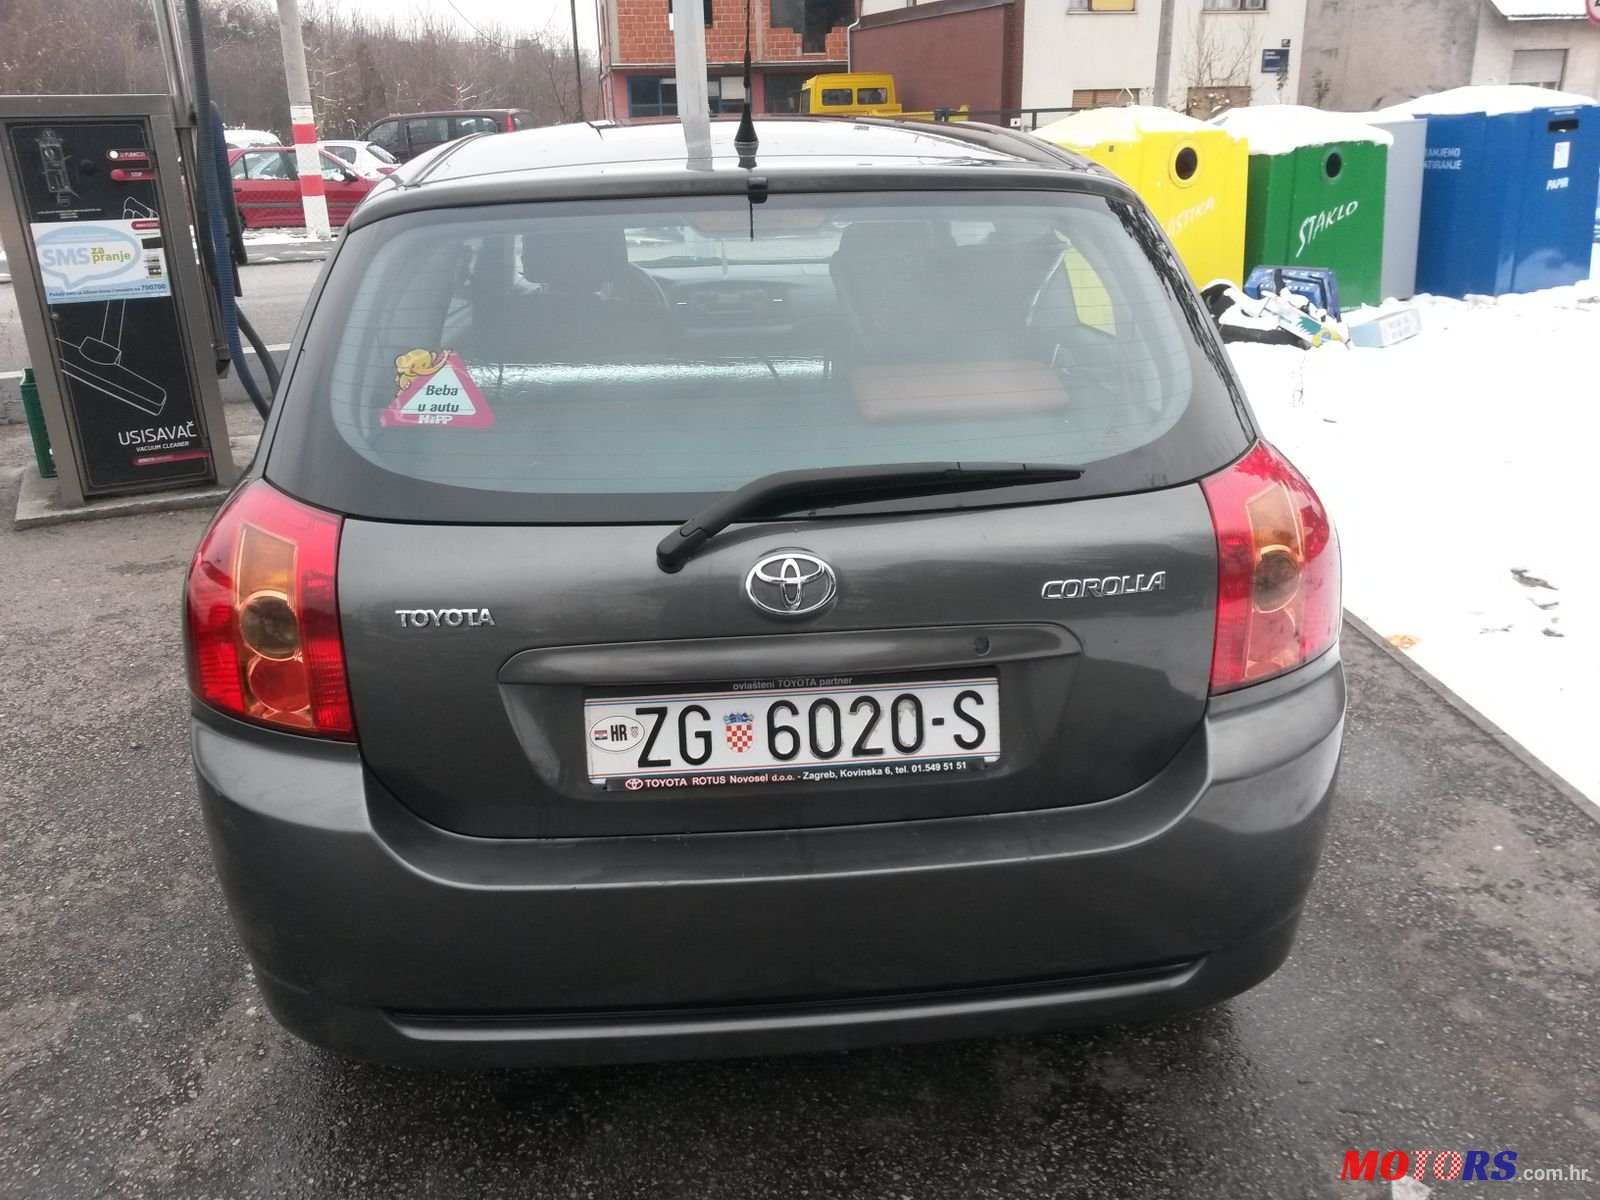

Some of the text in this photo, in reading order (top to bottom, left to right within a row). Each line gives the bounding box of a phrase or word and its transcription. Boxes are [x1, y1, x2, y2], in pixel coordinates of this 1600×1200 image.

[1163, 195, 1215, 239] ASTIKA
[1296, 201, 1358, 258] STAKLO
[41, 247, 91, 267] SMS
[91, 247, 104, 255] za
[92, 250, 132, 264] pranje
[425, 384, 458, 396] Beba
[417, 402, 460, 413] u autu
[418, 414, 453, 424] HiPP
[118, 420, 197, 445] USISAVAČ
[136, 440, 190, 452] VACUUM CLEANER
[1041, 570, 1166, 600] COROLLA
[395, 608, 495, 627] TOYOTA
[732, 677, 853, 690] ovlašteni TOYOTA partner
[610, 724, 628, 742] HR
[635, 690, 986, 768] ZG 6020-S
[645, 777, 688, 788] TOYOTA
[692, 775, 726, 785] ROTUS
[730, 773, 768, 784] Novosel
[771, 772, 795, 782] d.o.o.
[803, 770, 838, 781] Zagreb,
[840, 767, 883, 778] Kovinska
[885, 766, 893, 776] 6,
[895, 765, 909, 774] tel.
[911, 763, 941, 773] 01.549
[943, 762, 953, 771] 51
[956, 761, 967, 770] 51
